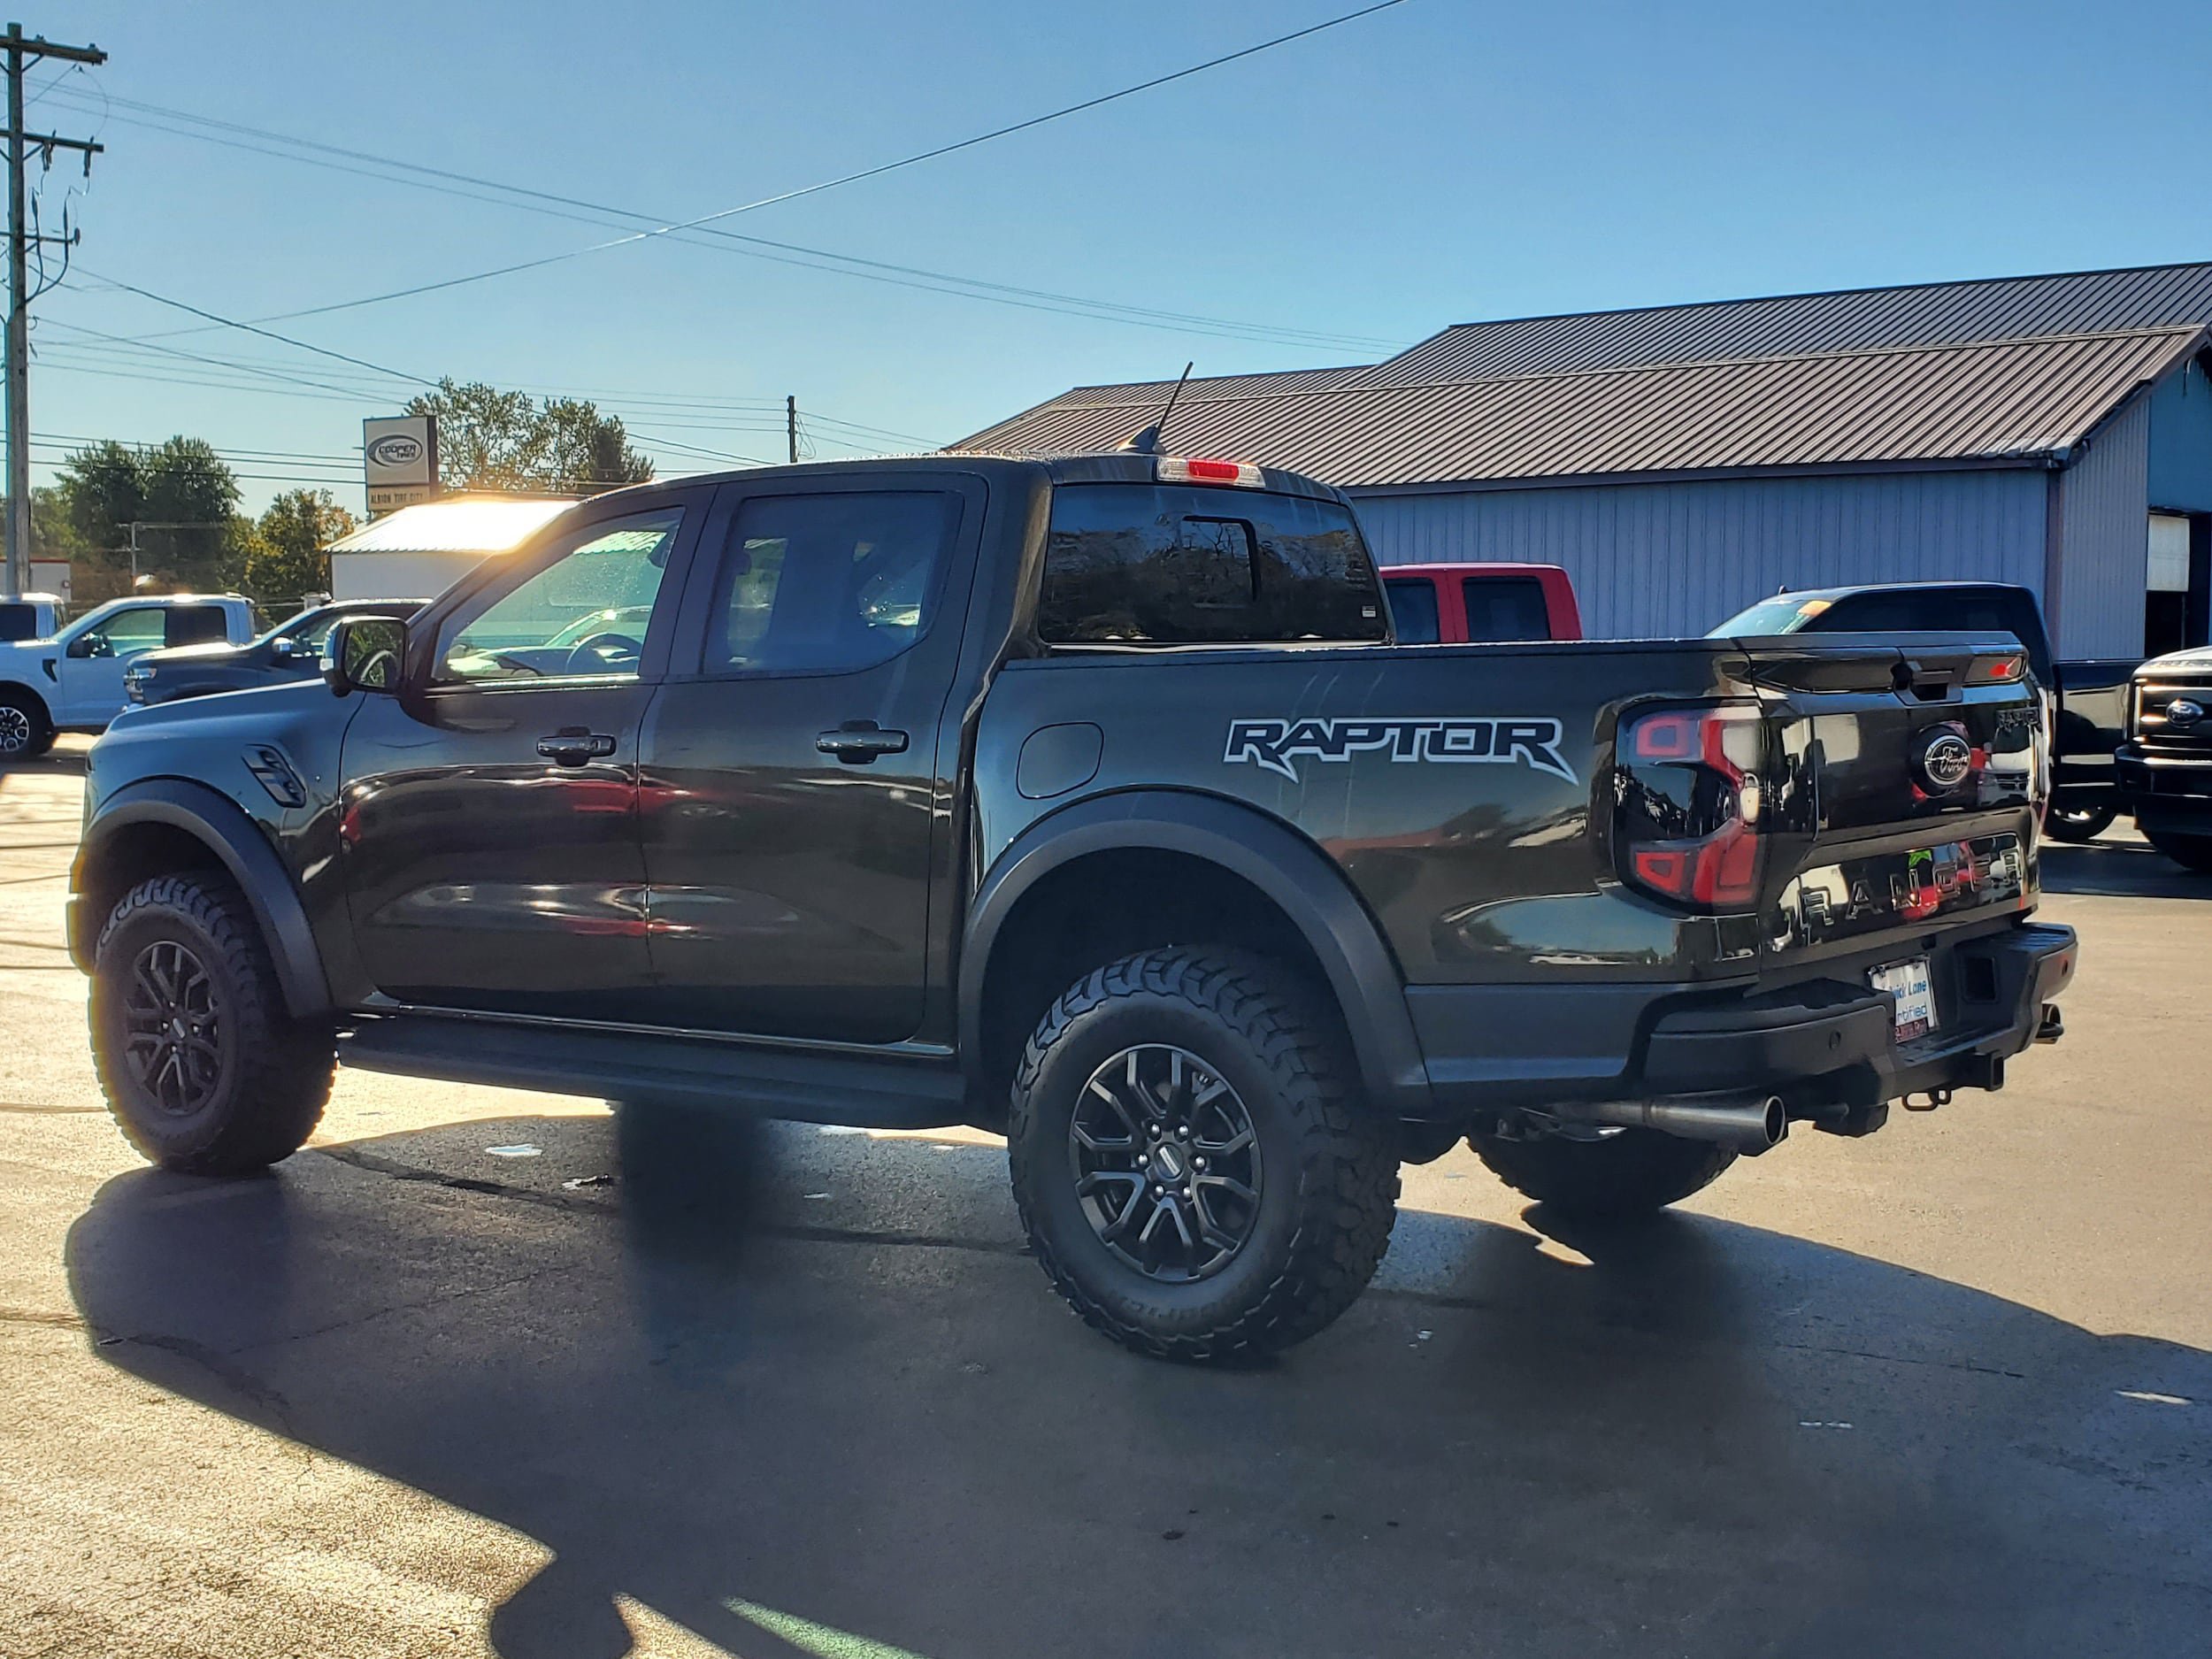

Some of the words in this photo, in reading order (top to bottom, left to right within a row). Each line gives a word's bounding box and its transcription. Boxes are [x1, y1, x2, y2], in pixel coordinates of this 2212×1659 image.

[379, 444, 417, 454] COOPER
[1223, 717, 1579, 787] RAPTOR
[1799, 846, 2022, 928] RANGER
[1908, 980, 1926, 995] Lane
[1896, 1002, 1927, 1023] rtified
